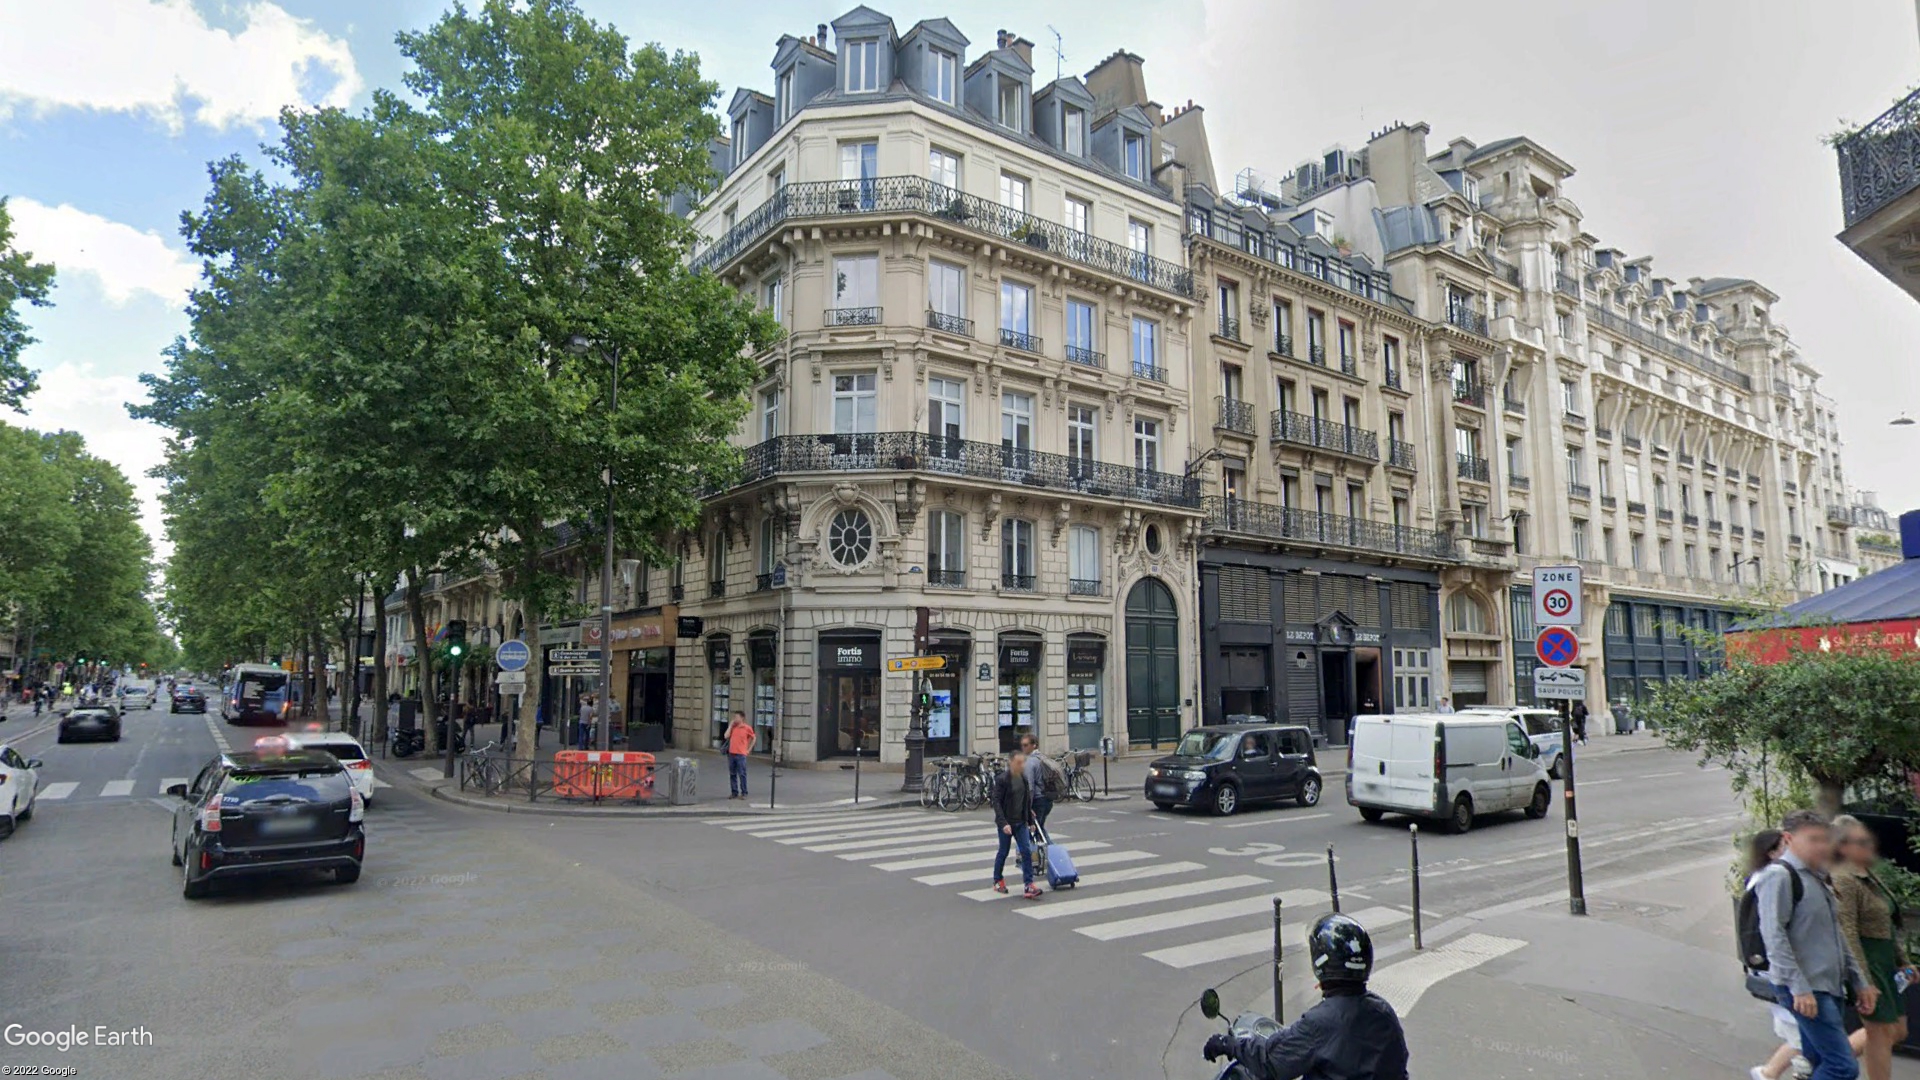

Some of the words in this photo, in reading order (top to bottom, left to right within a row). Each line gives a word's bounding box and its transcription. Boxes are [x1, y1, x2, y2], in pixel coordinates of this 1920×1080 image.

[1542, 573, 1573, 582] ZONE
[1549, 597, 1567, 609] 30
[837, 647, 862, 655] Fortis
